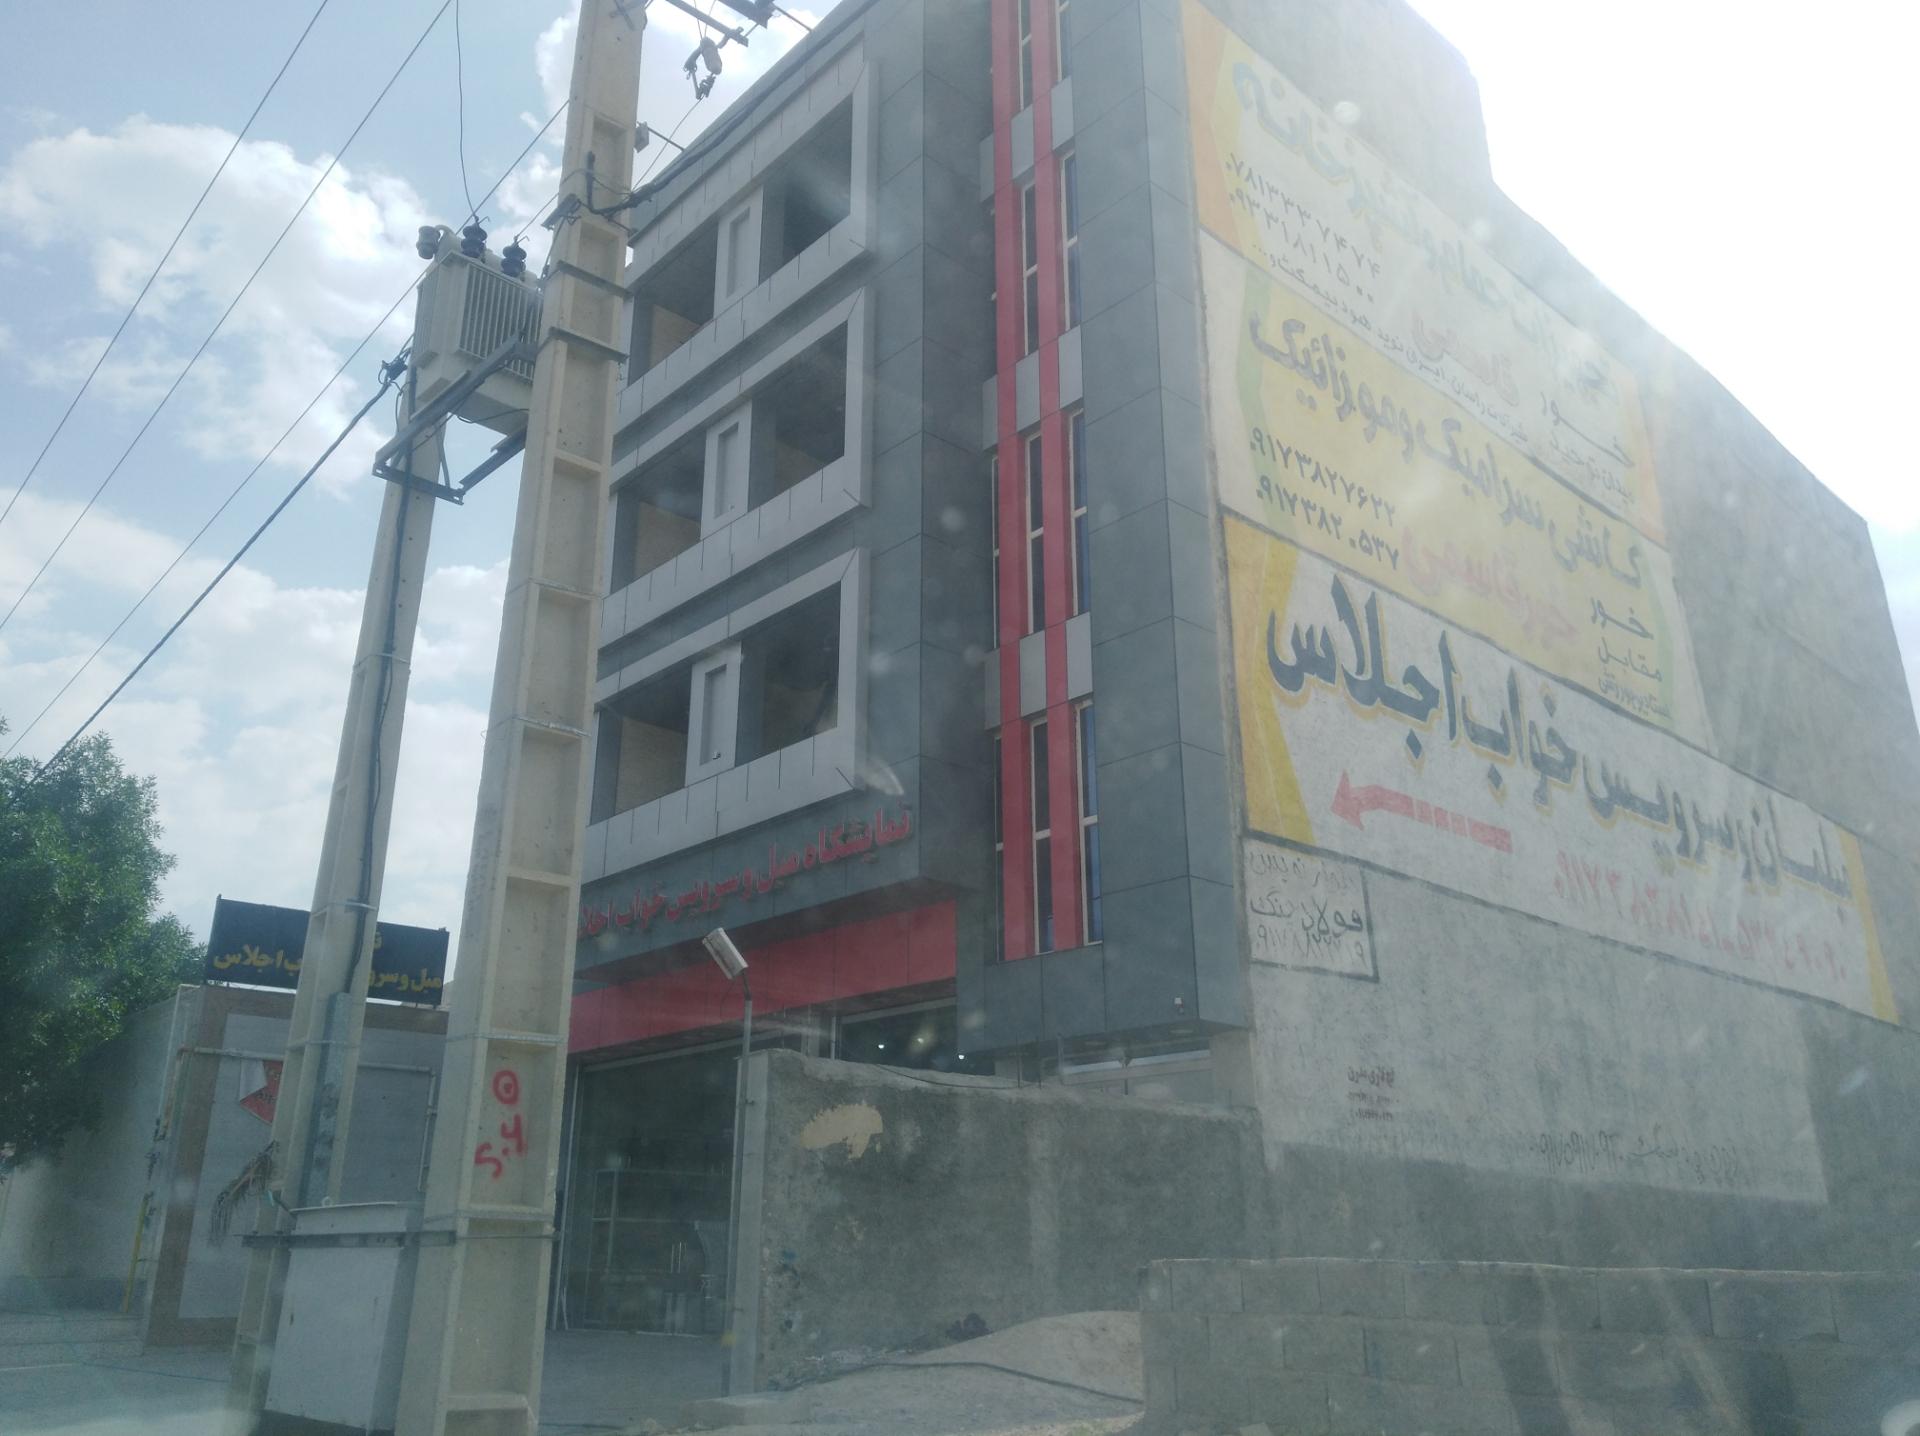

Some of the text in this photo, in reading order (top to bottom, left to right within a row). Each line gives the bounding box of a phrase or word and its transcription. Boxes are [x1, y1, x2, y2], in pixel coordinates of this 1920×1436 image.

[1419, 418, 1543, 530] سرامیک
[1256, 474, 1398, 569] ۰۹۱۷۳۸۲۰۵۳۷
[1548, 504, 1640, 589] کاشی
[1590, 597, 1653, 639] خور
[1267, 575, 1455, 762] اجلاس
[1597, 637, 1662, 682] مقابل
[1461, 668, 1576, 808] خواب
[756, 842, 801, 893] مبل
[802, 798, 913, 870] نمایشگاه
[213, 943, 285, 974] اجلاس
